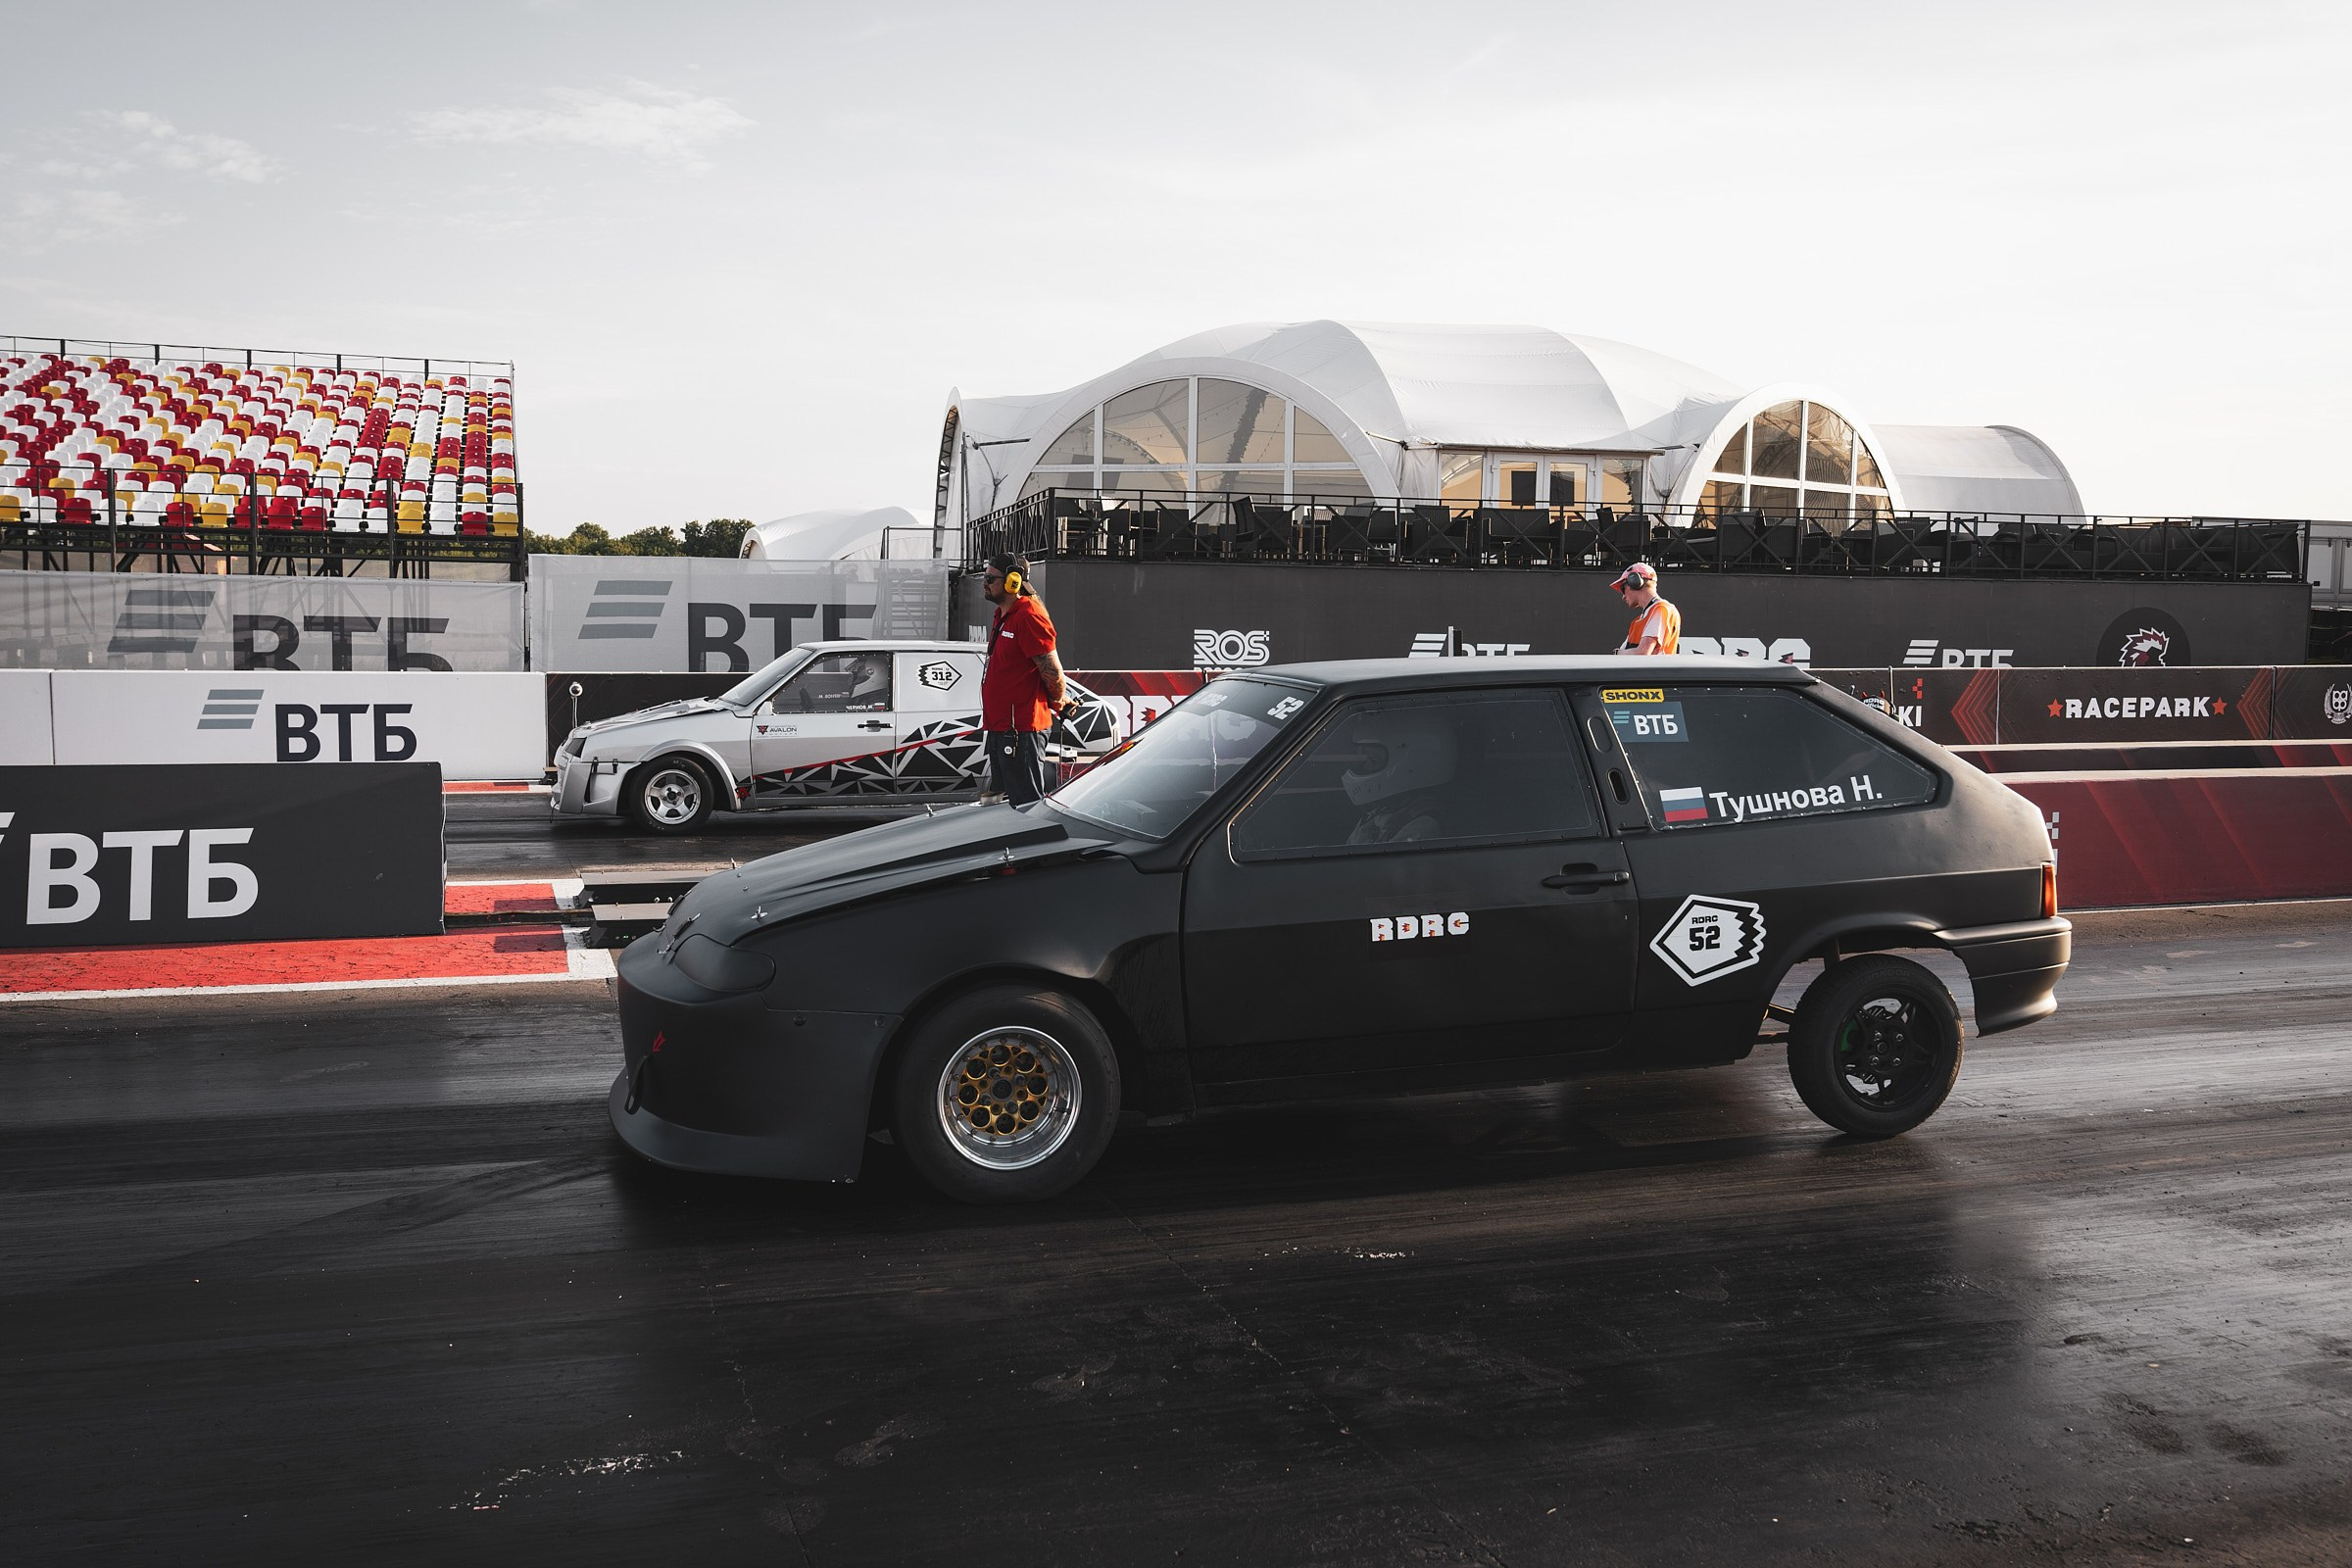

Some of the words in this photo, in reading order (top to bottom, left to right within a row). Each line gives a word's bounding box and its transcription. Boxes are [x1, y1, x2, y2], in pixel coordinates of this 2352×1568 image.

[1194, 629, 1269, 665] ROS
[932, 671, 953, 681] 312
[1267, 696, 1304, 720] 52
[1605, 691, 1662, 701] SHONX
[2065, 696, 2211, 718] RACEPARK
[274, 704, 417, 761] ВТБ
[1633, 713, 1679, 735] ВТБ
[1709, 785, 1845, 822] Тушнова
[1850, 774, 1883, 802] Н.
[26, 827, 259, 925] ВТБ
[1370, 911, 1470, 942] RDRC
[1691, 914, 1719, 925] RDRC
[1689, 925, 1721, 952] 52
